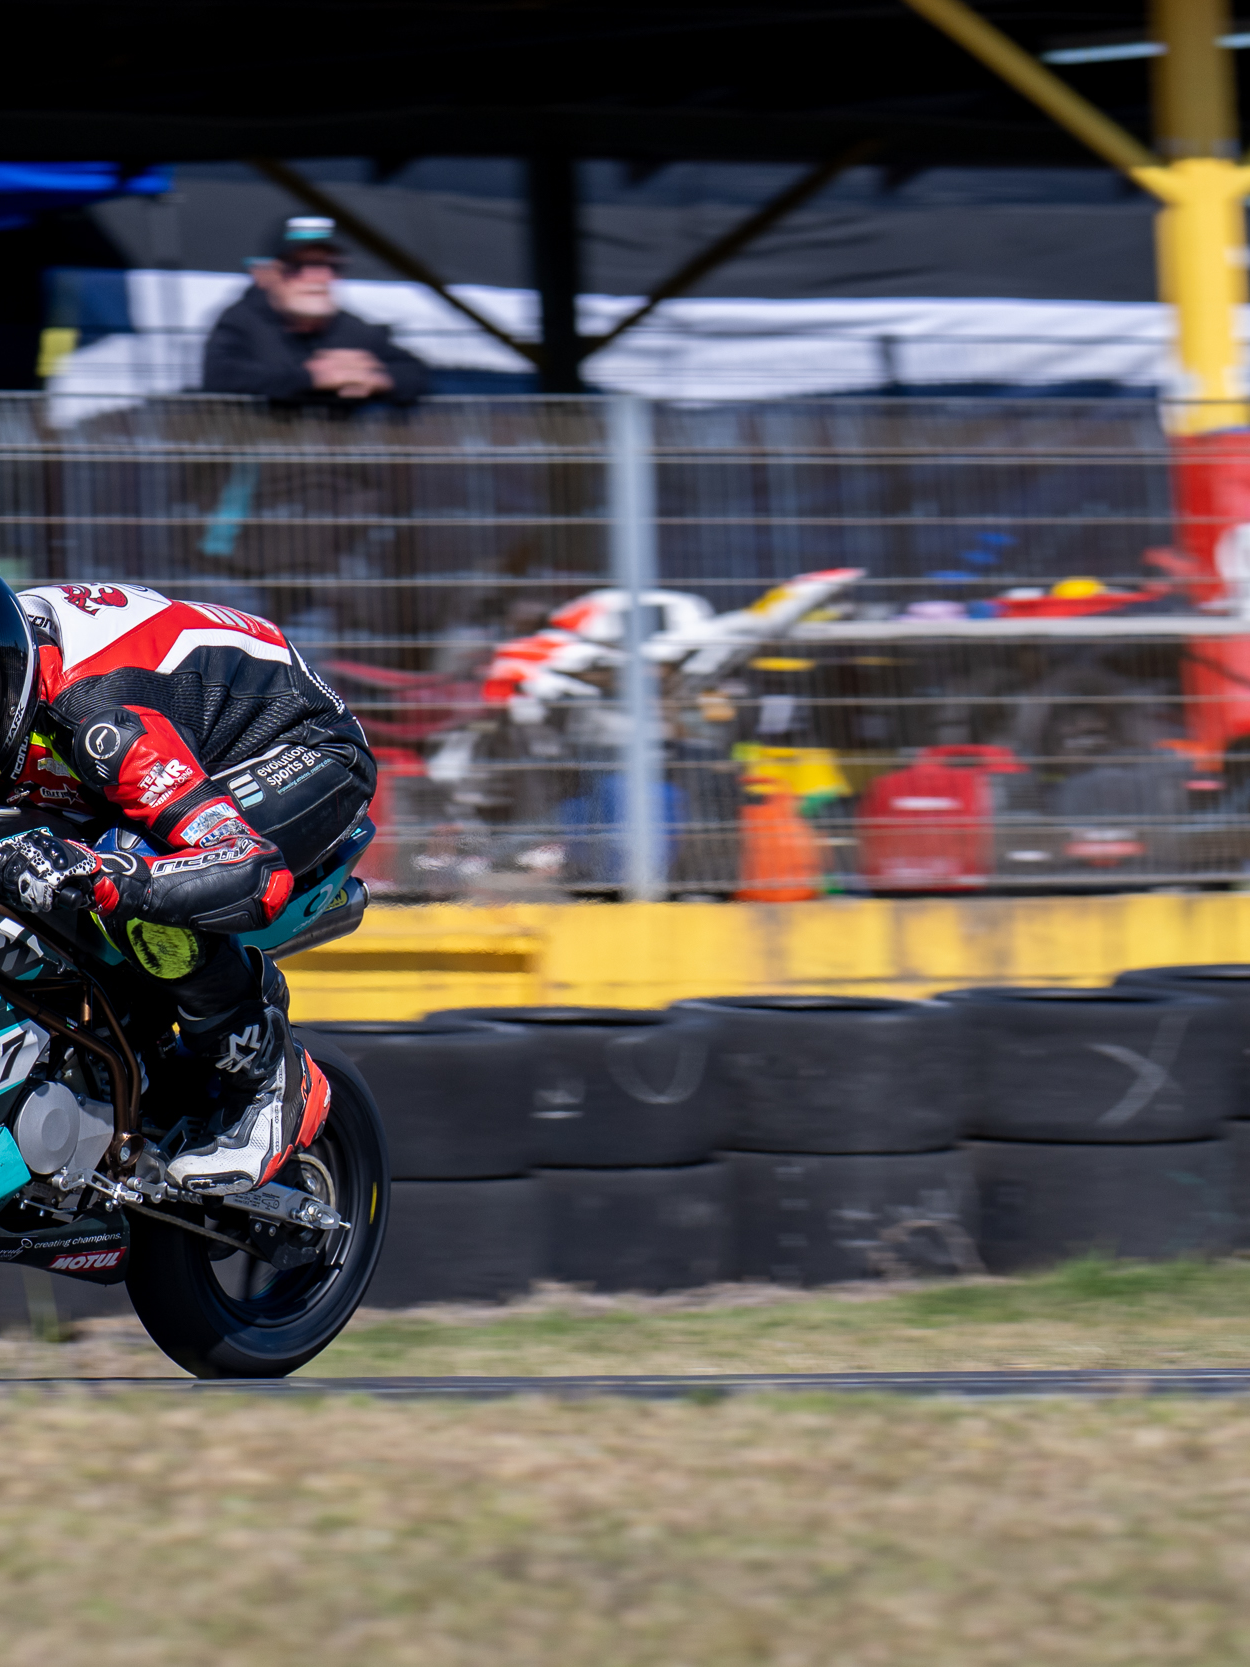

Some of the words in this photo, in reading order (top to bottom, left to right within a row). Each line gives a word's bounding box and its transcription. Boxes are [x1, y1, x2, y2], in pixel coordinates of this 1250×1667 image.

[257, 745, 308, 777] evolution
[266, 760, 304, 787] sports
[34, 1238, 71, 1250] creating
[71, 1232, 122, 1246] champions.
[51, 1251, 120, 1270] MOTUL
